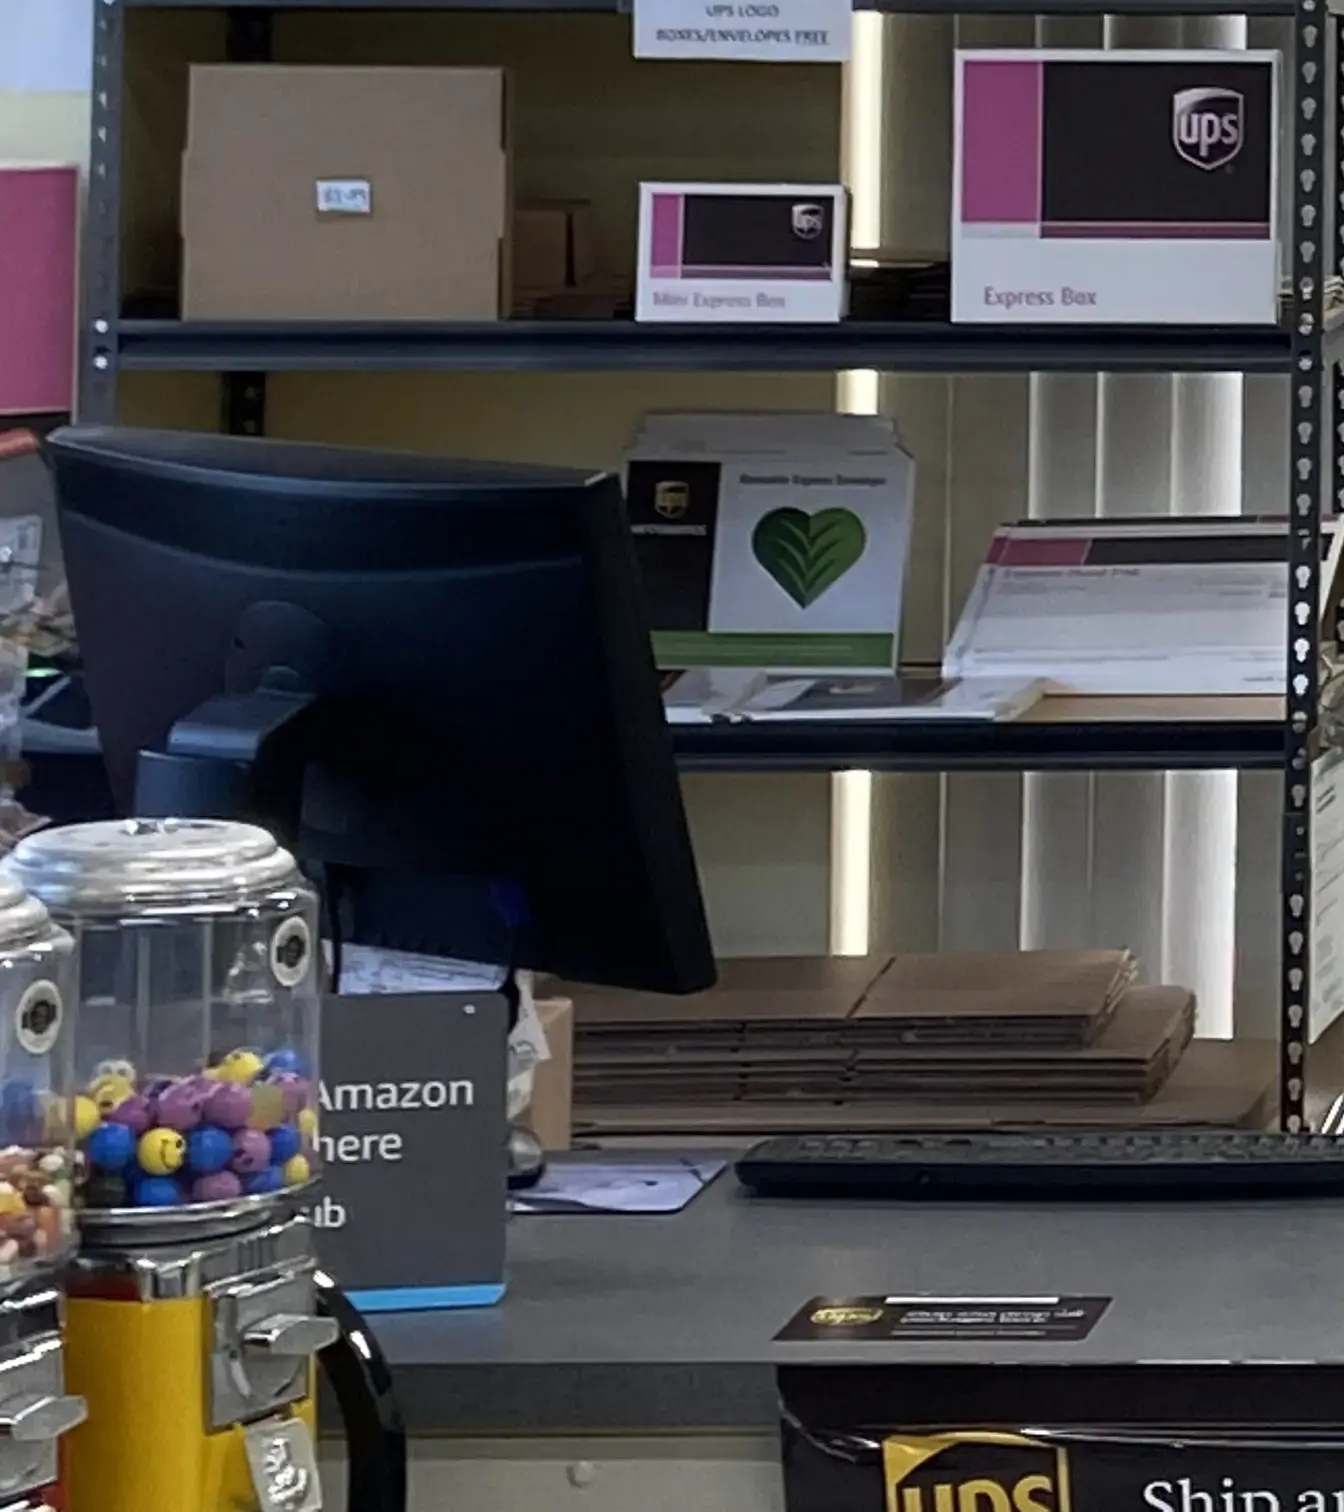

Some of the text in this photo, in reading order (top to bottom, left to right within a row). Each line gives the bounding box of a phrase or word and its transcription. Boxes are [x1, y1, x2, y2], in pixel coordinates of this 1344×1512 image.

[1179, 111, 1240, 157] ups
[983, 286, 1097, 309] Express Box
